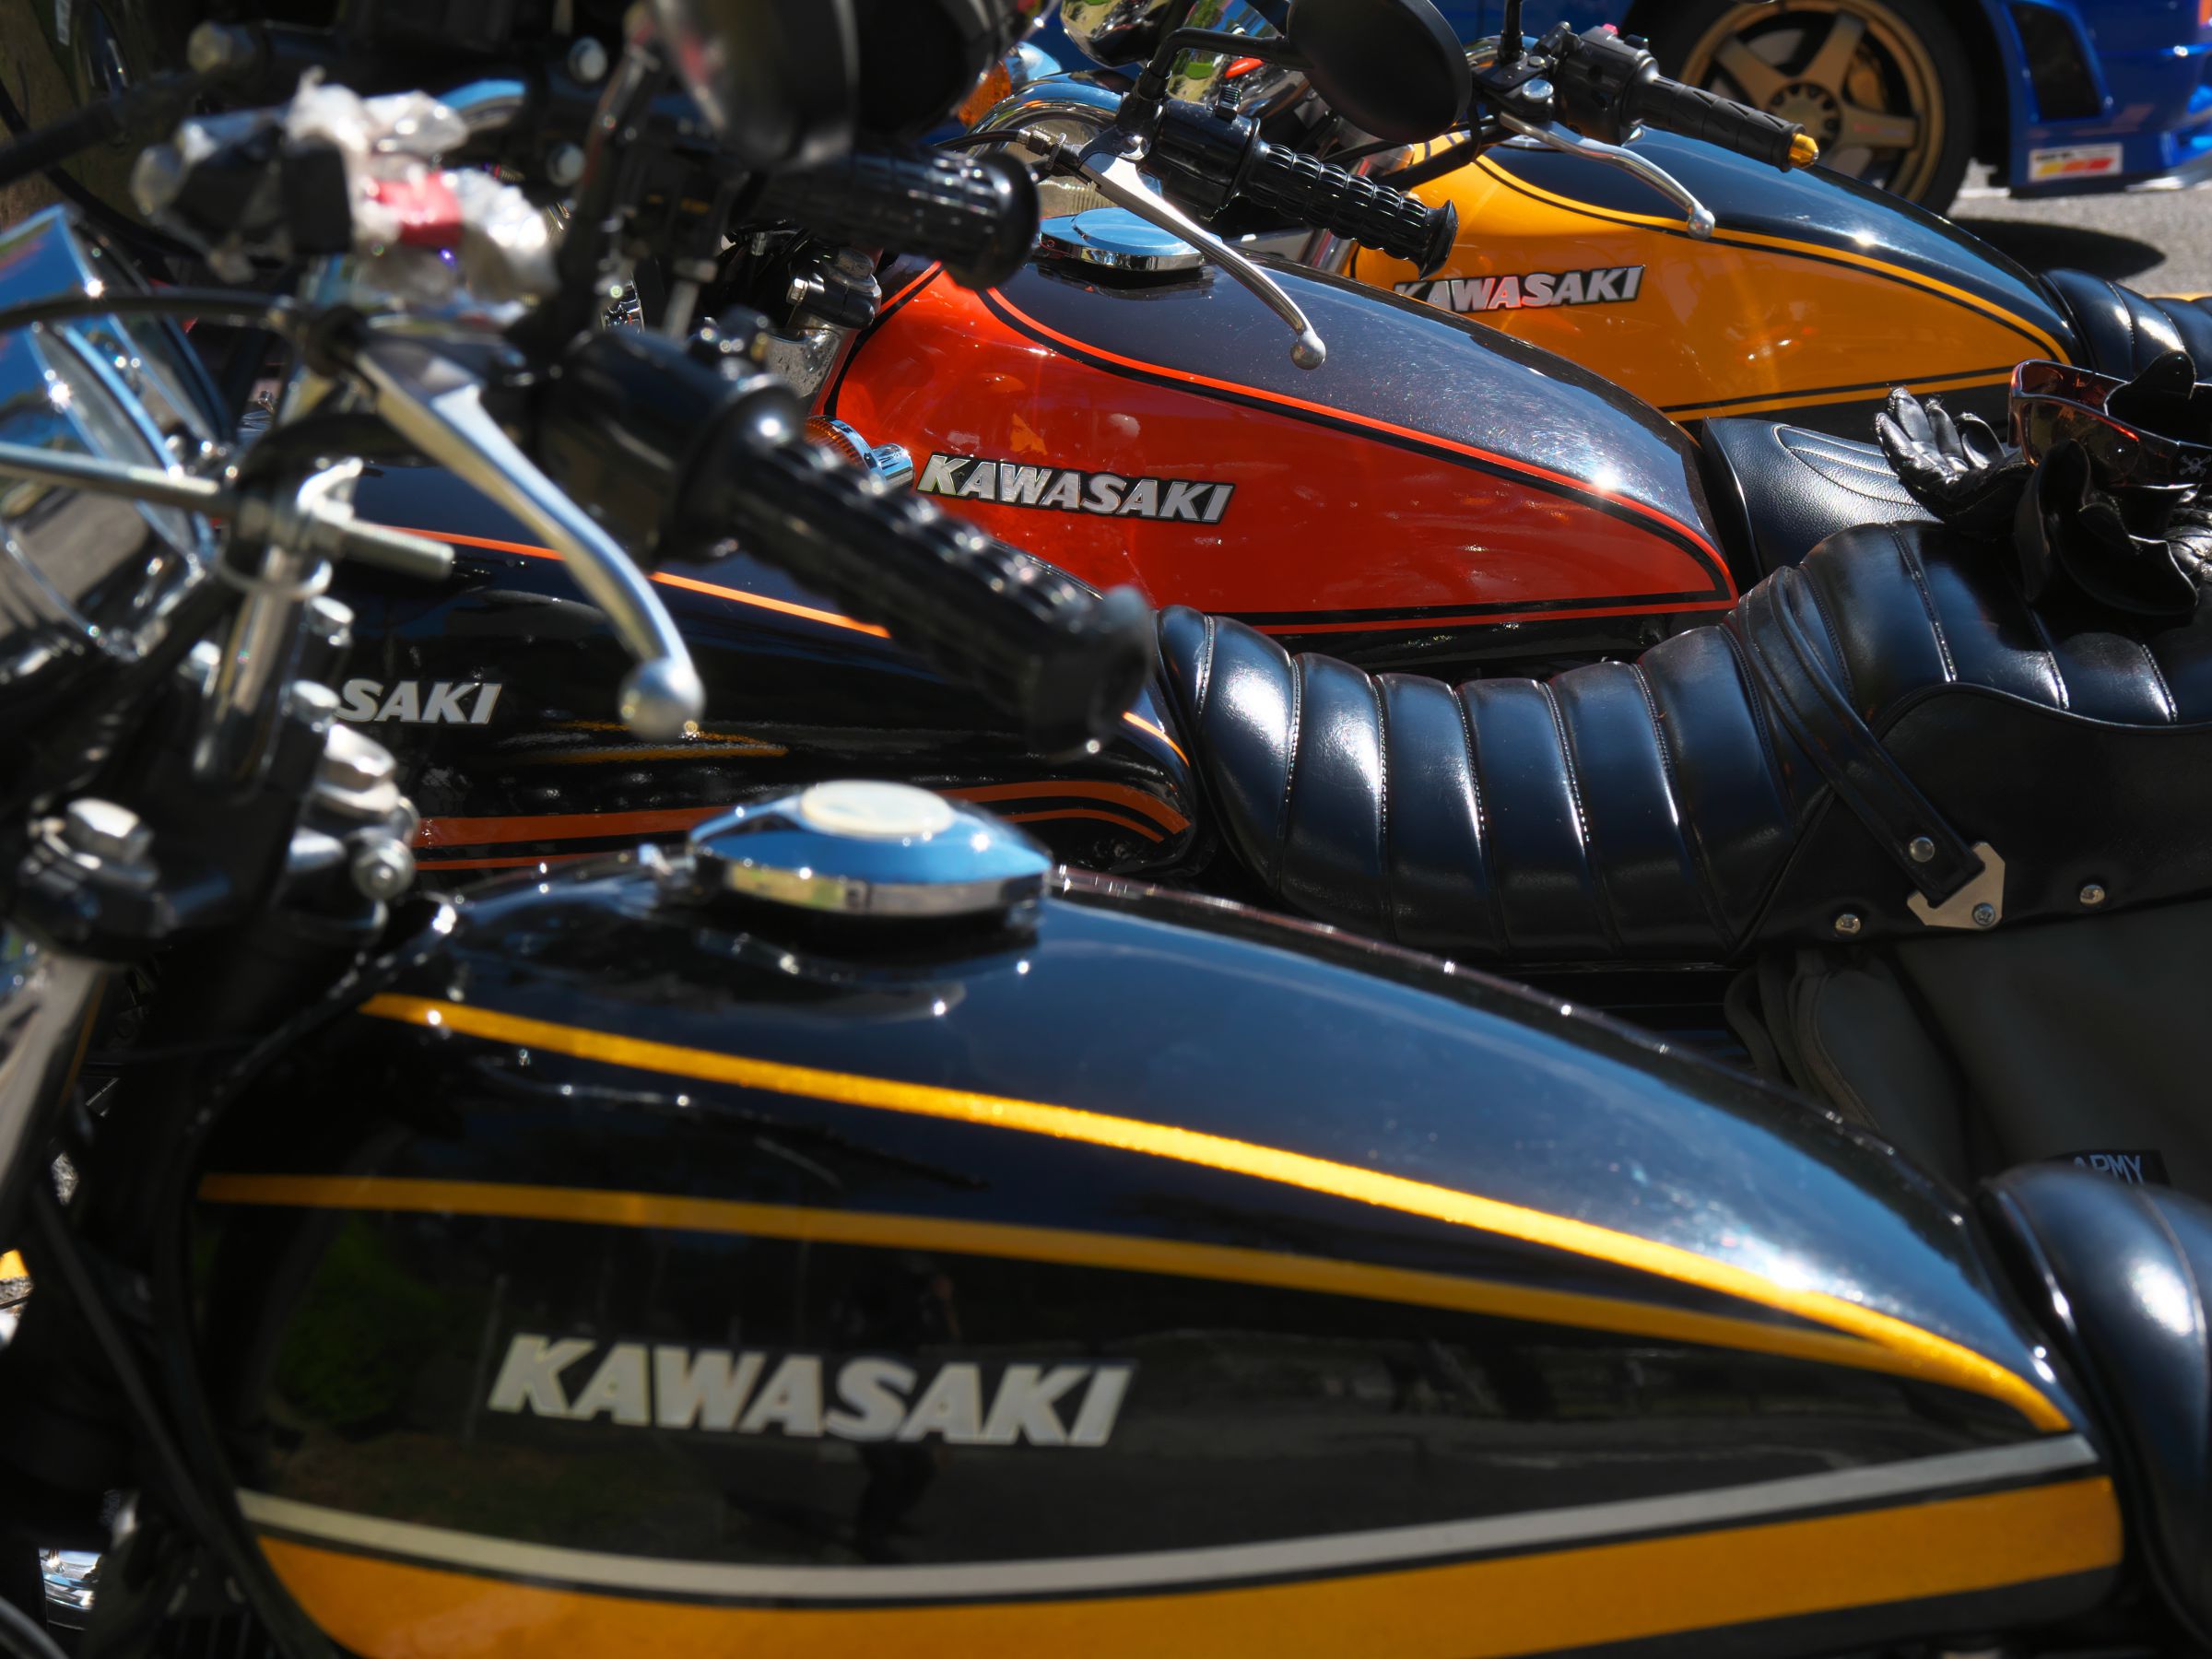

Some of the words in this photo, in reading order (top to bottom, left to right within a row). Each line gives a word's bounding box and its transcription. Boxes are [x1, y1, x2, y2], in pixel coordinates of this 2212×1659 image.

[917, 454, 1233, 523] KAWASAKI
[333, 678, 501, 724] SAKI
[488, 1333, 1133, 1446] KAWASAKI
